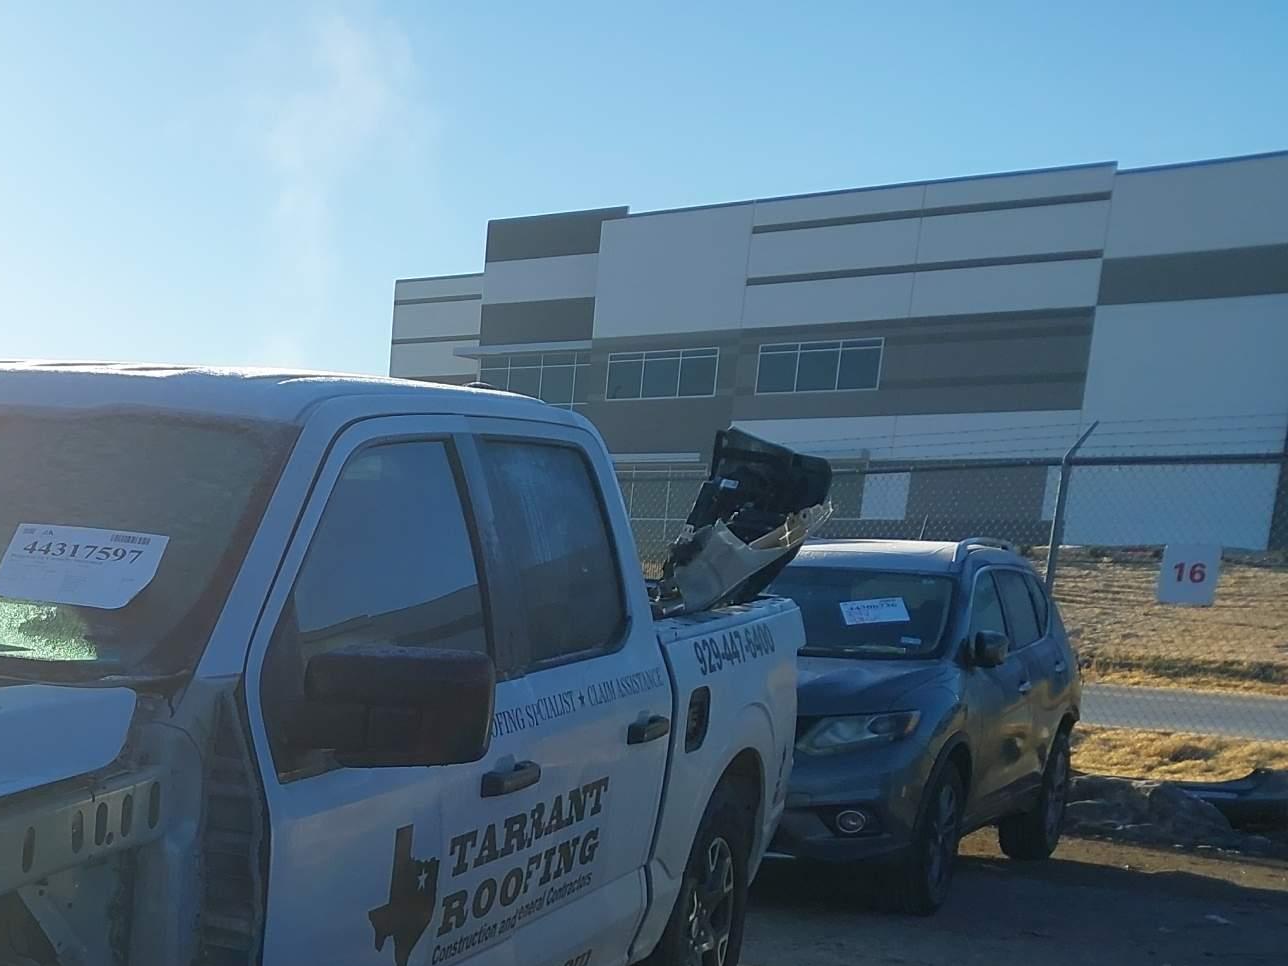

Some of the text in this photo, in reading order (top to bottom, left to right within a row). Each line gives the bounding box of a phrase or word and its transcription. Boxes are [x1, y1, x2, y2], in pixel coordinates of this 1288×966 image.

[23, 540, 144, 565] 44317597
[1174, 562, 1206, 584] 16
[694, 623, 775, 676] 929-447-6400
[587, 679, 616, 707] CLAIM
[615, 666, 665, 698] ASSISTANCE
[449, 776, 610, 878] TARRANT
[436, 827, 600, 938] ROOFING
[431, 921, 498, 966] Construction
[498, 908, 518, 933] and
[545, 871, 593, 906] Contractors
